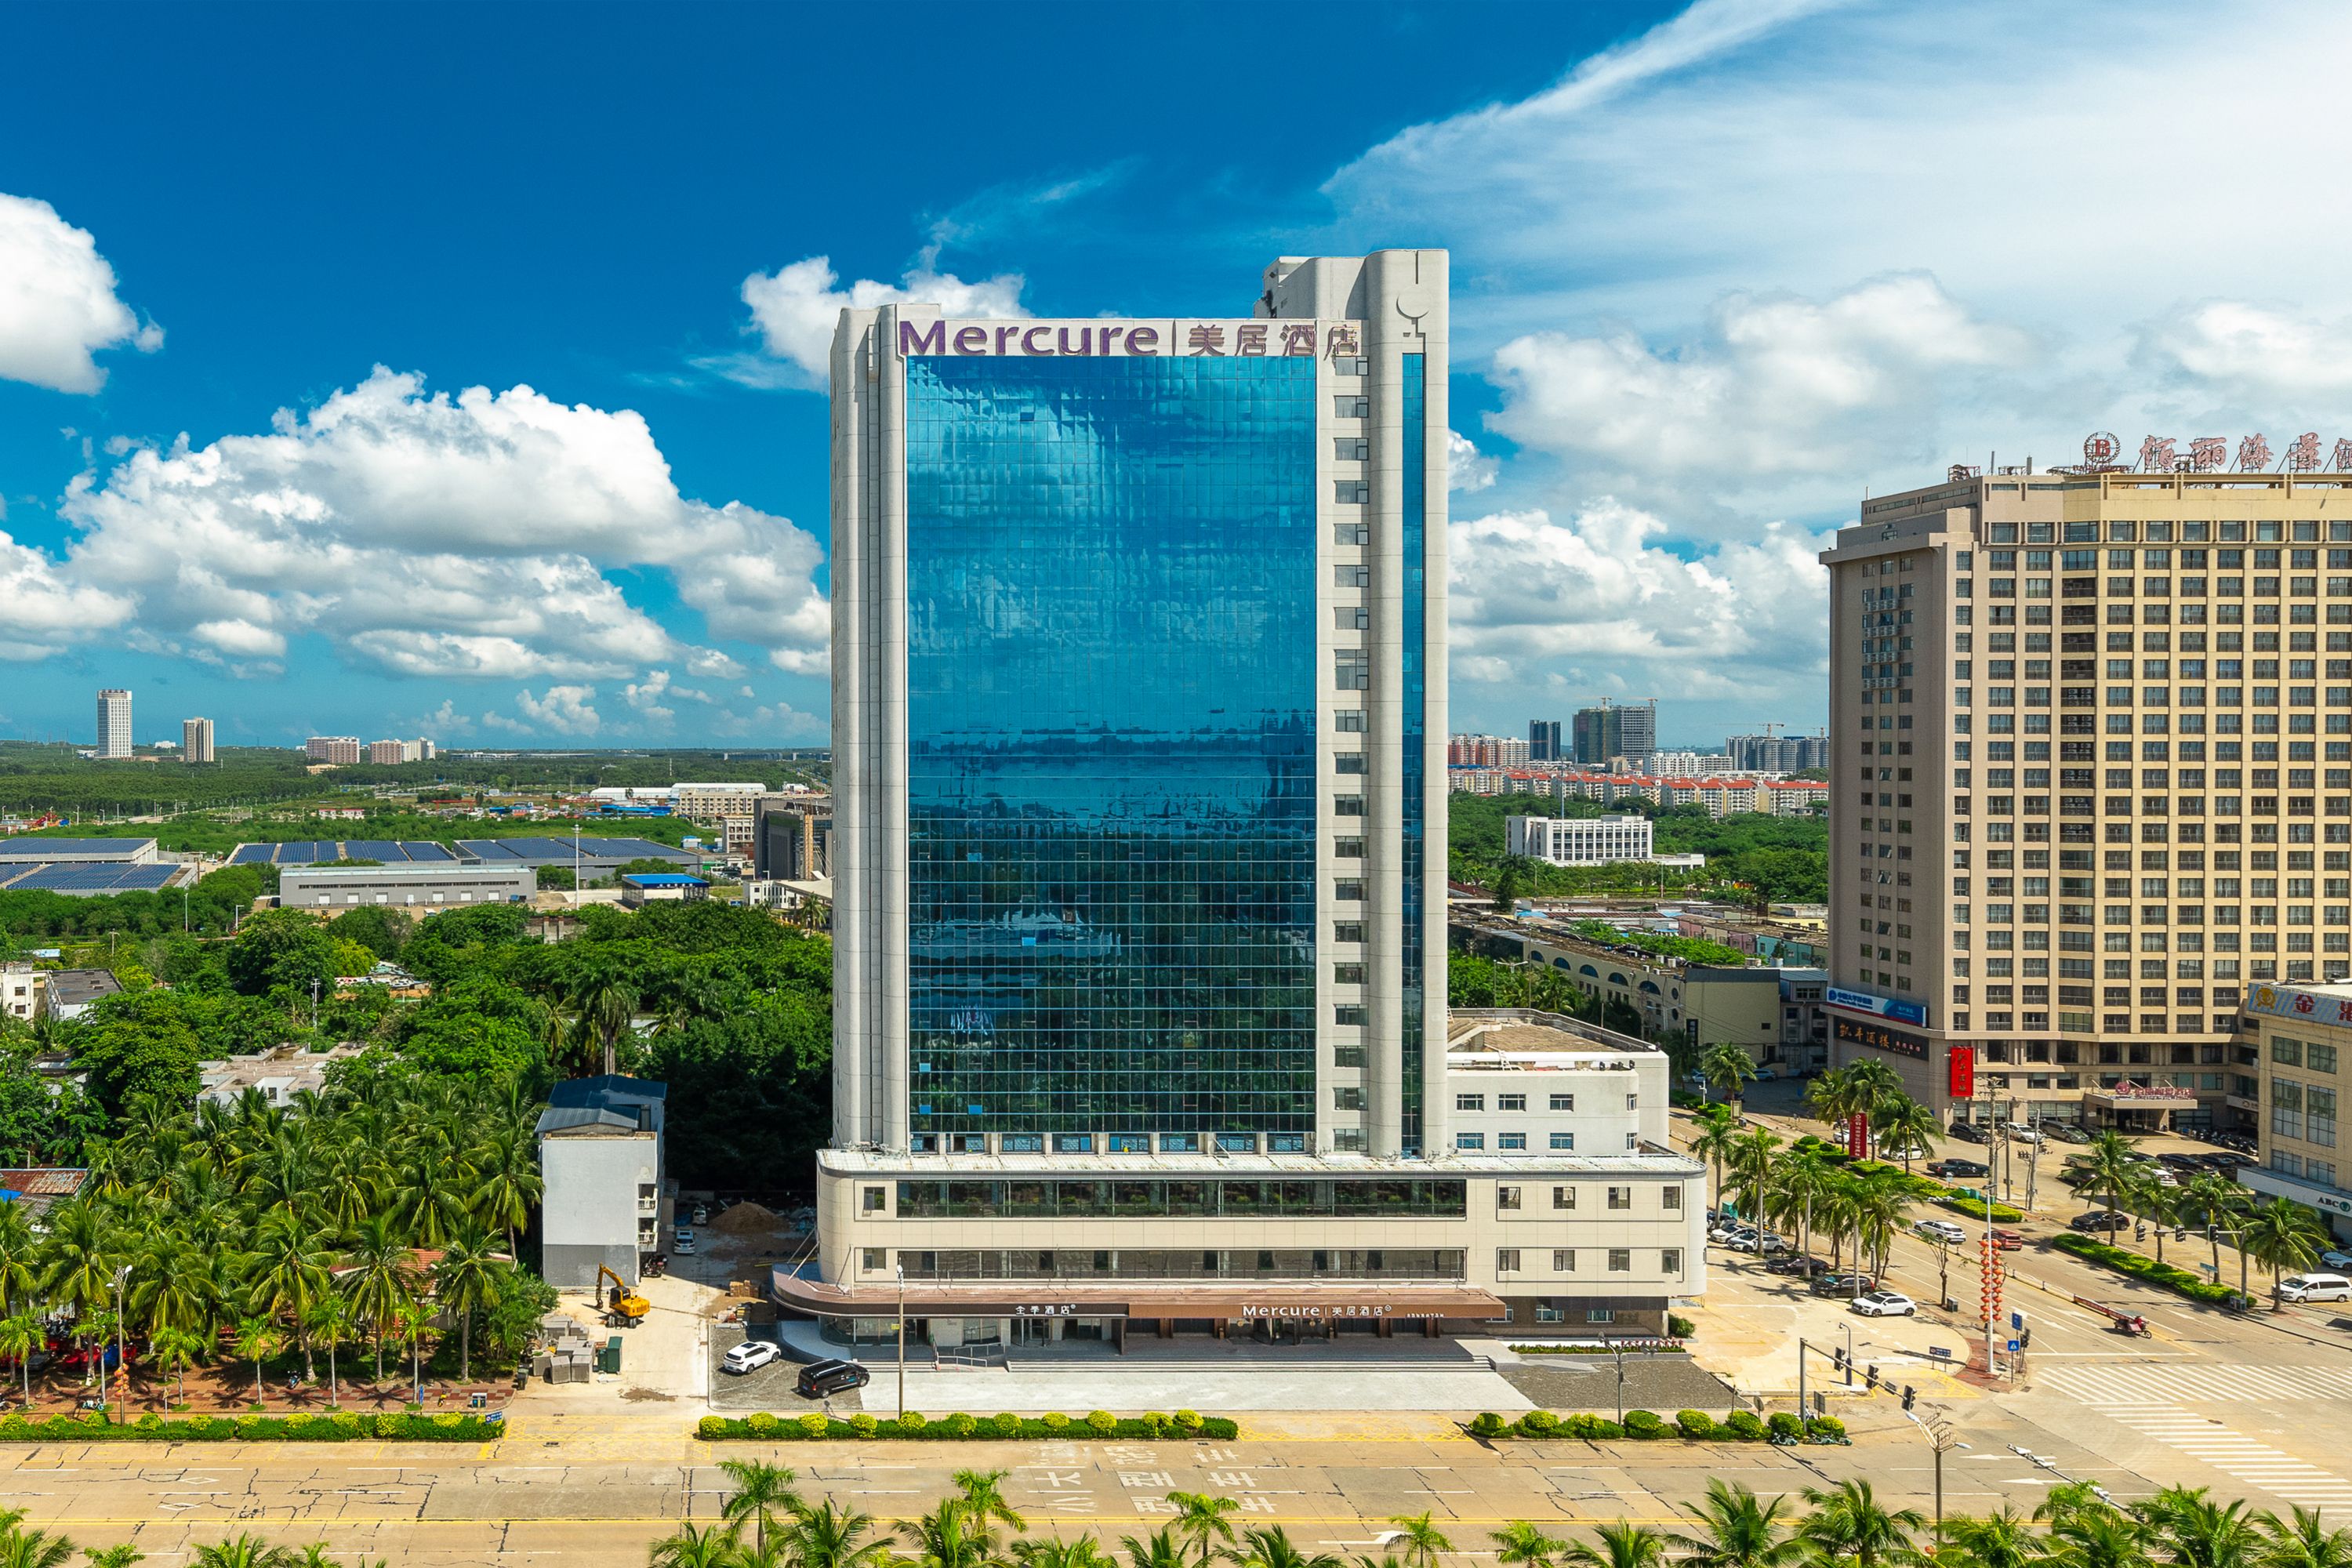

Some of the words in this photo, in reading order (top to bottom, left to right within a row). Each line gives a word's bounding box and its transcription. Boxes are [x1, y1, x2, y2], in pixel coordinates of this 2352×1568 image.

[899, 319, 1159, 356] Mercure
[1187, 324, 1361, 361] 美居酒店
[2094, 438, 2111, 457] B
[2318, 1196, 2339, 1208] ABC
[1015, 1305, 1070, 1316] 全季酒店
[1243, 1305, 1320, 1316] Mercure
[1332, 1305, 1383, 1316] 美居酒店
